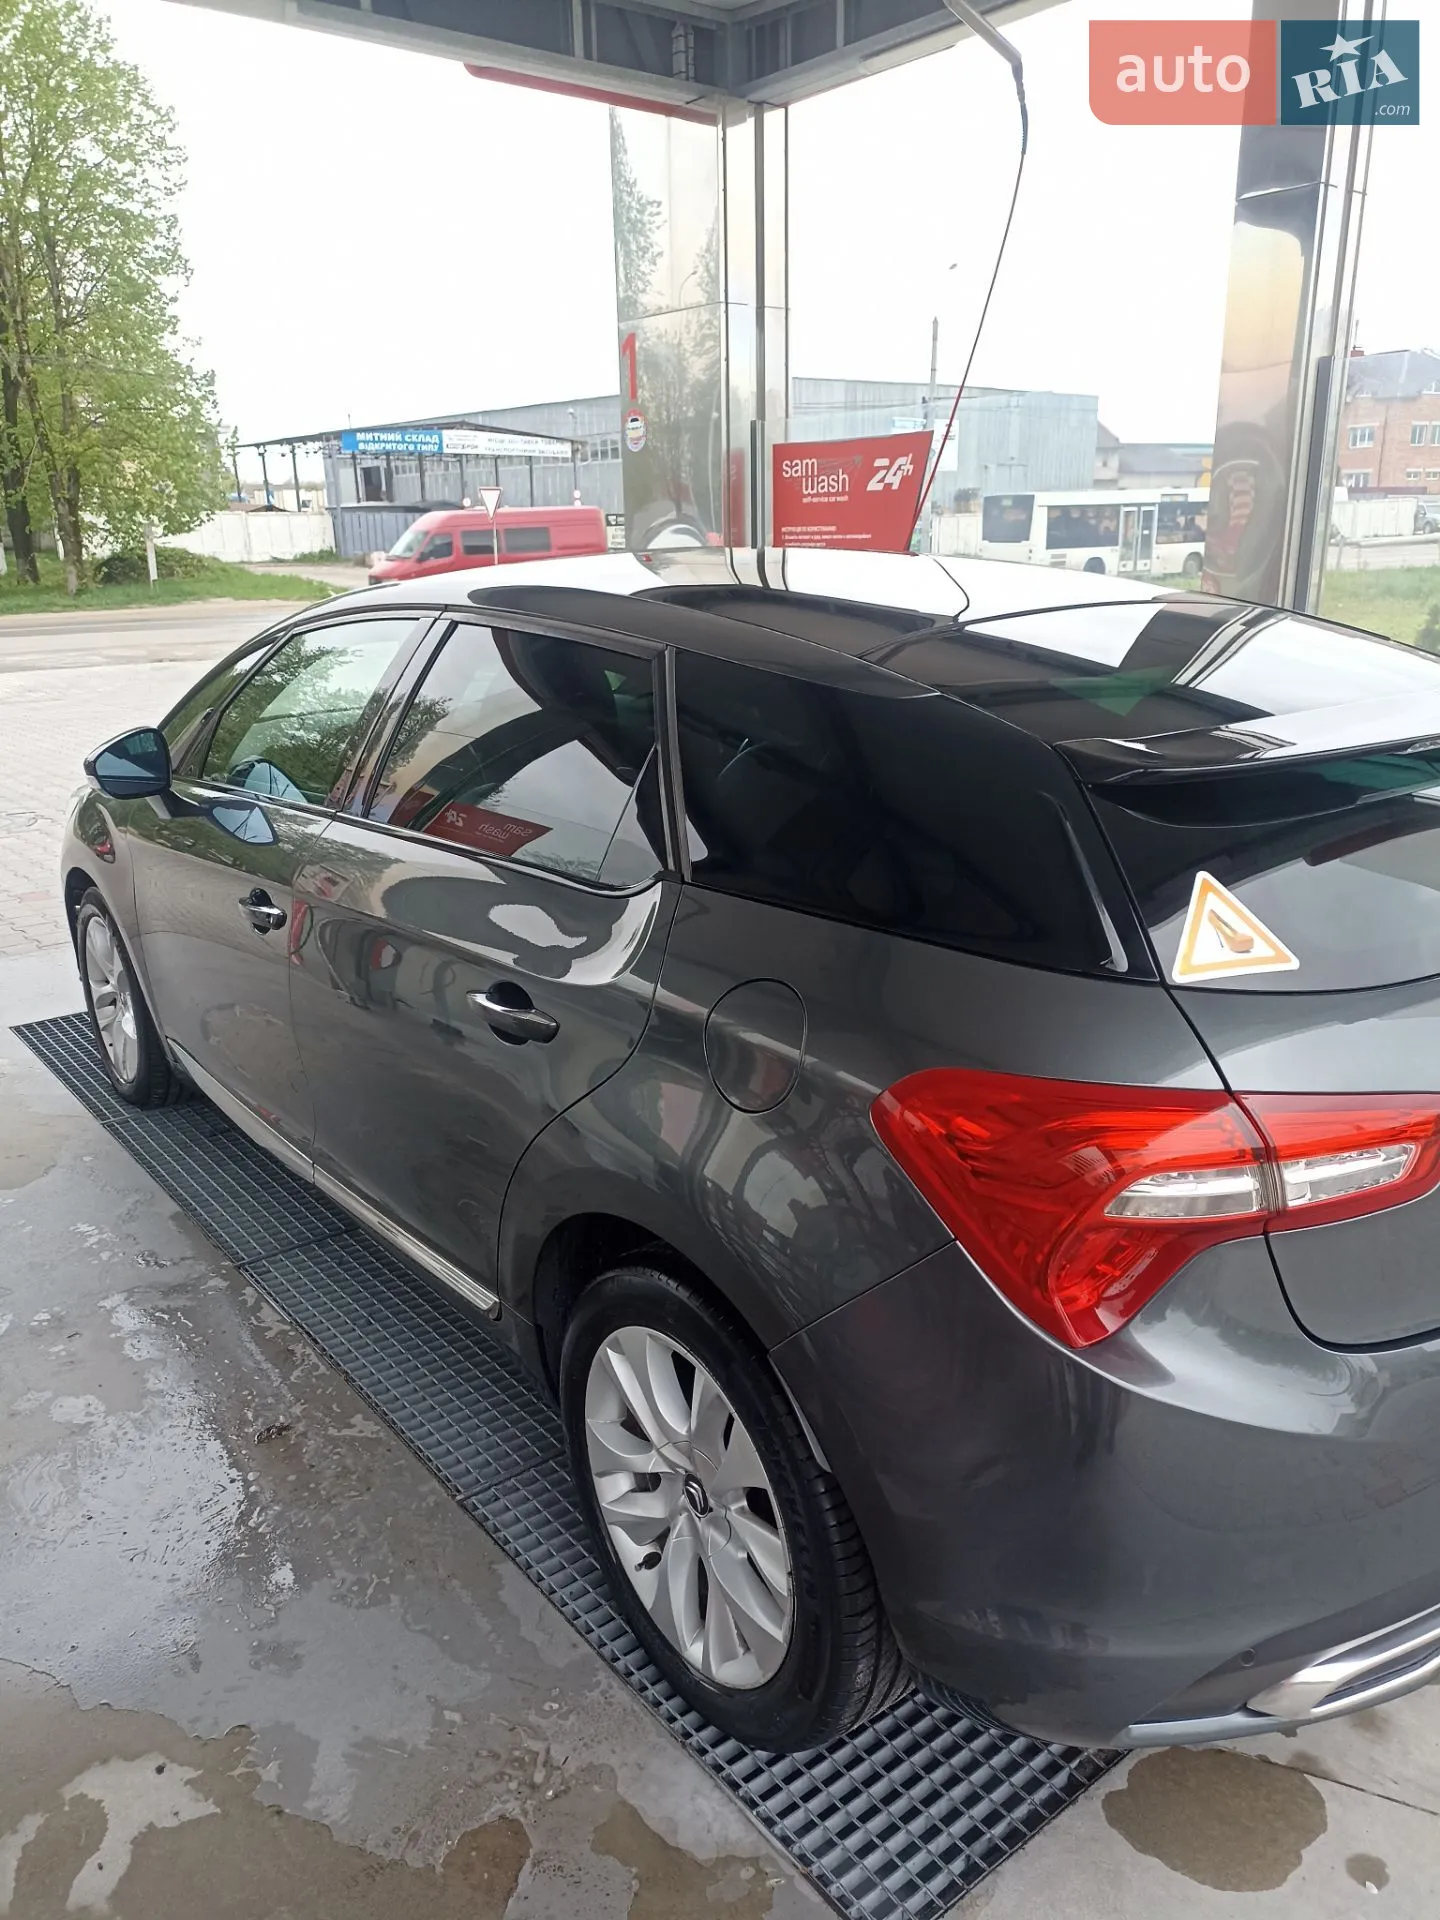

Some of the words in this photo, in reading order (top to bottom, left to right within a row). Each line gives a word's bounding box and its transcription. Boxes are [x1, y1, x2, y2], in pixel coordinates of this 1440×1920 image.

[621, 332, 638, 402] 1
[356, 431, 402, 442] МИТНИЙ
[404, 433, 440, 444] СКЛАД
[417, 443, 439, 452] ТИПУ
[782, 458, 818, 478] sam
[866, 453, 914, 491] 24h
[802, 468, 849, 494] wash
